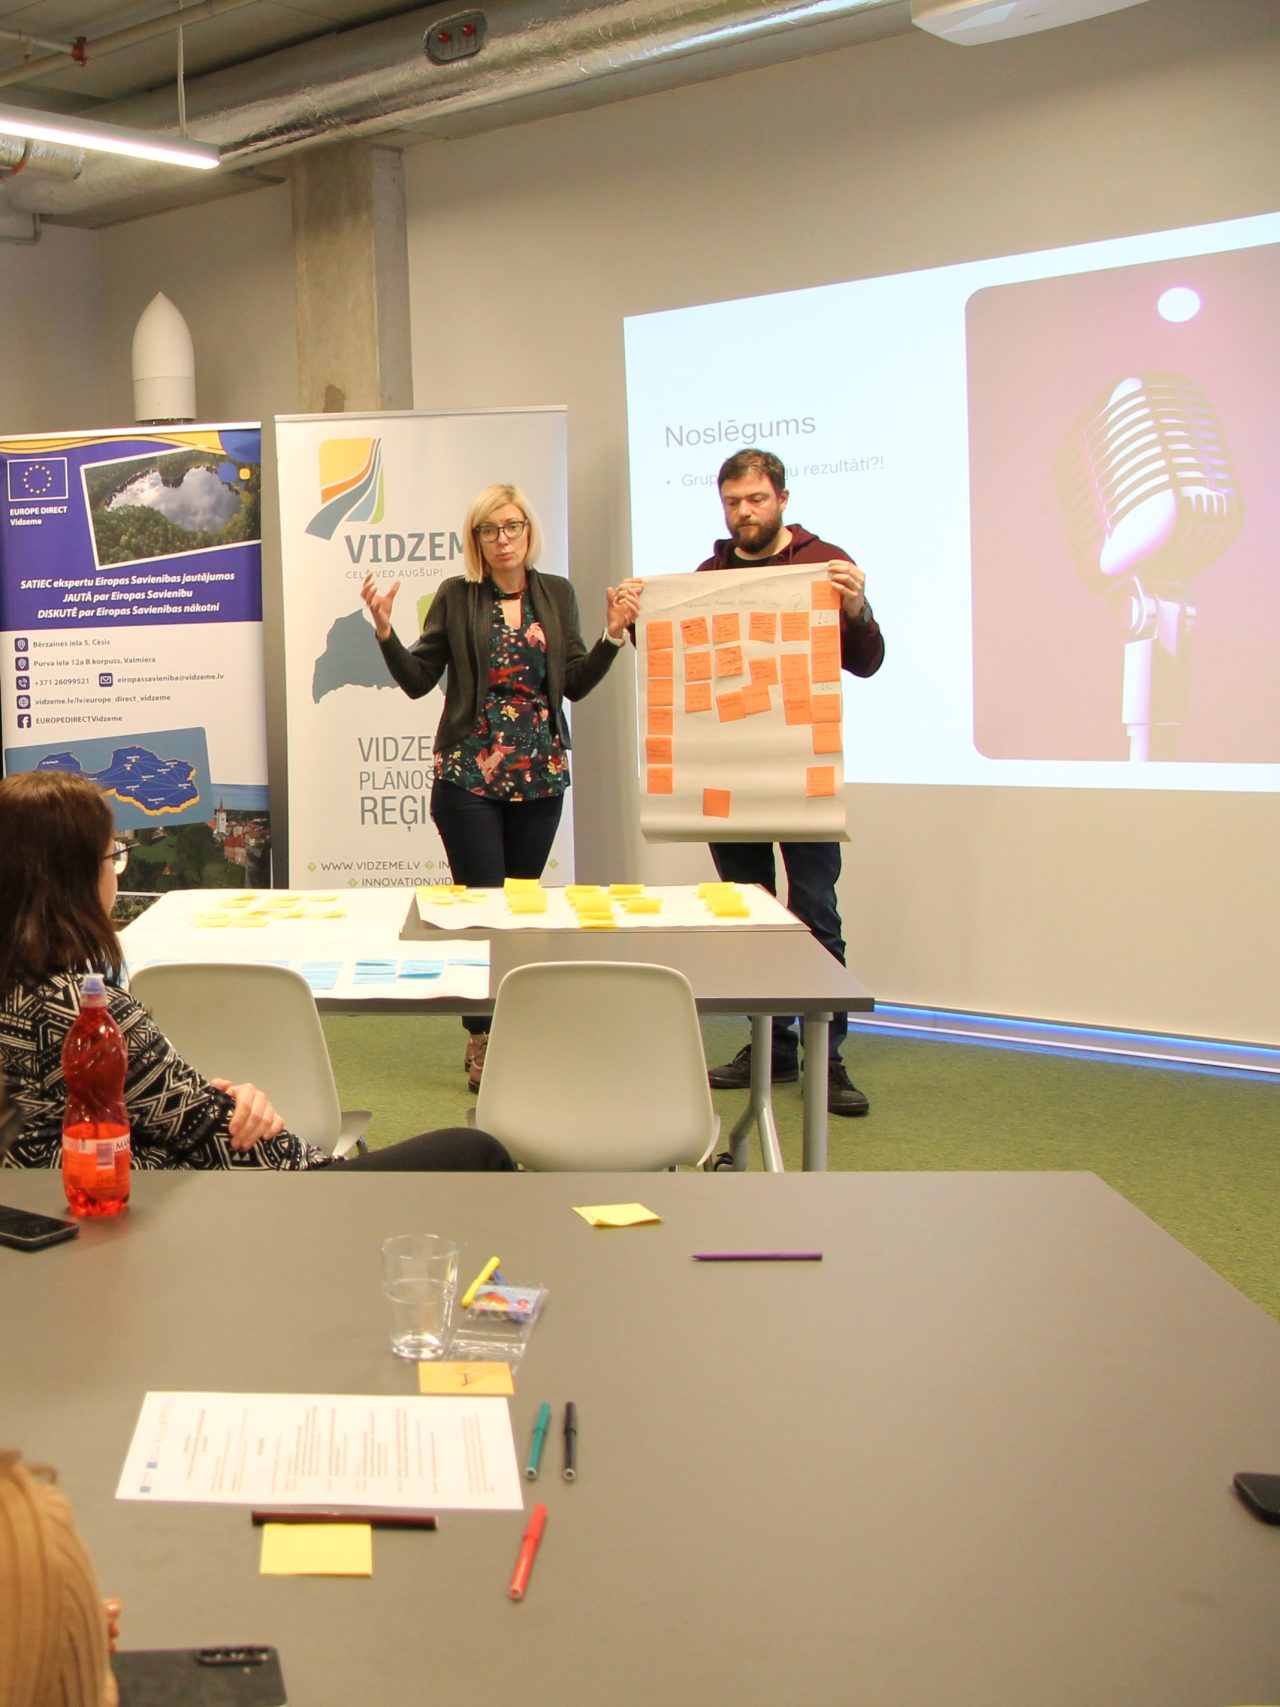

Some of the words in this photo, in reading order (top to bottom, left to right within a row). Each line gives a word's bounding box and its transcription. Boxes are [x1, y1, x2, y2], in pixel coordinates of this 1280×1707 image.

[665, 415, 817, 448] Noslēgums
[681, 472, 720, 488] Grup
[803, 456, 885, 476] rezultāti?!
[9, 507, 40, 516] EUROPE
[40, 505, 68, 515] DIRECT
[9, 518, 43, 526] Vidzeme
[344, 531, 465, 564] VIDZEM
[375, 569, 396, 579] VED
[398, 567, 444, 578] AUGŠUP!
[20, 579, 53, 589] SATIEC
[53, 578, 94, 589] ekspertu
[94, 576, 130, 587] Eiropas
[130, 574, 181, 585] Savienības
[181, 572, 236, 585] jautājumos
[62, 591, 92, 603] JAUTĀ
[92, 593, 110, 603] par
[110, 591, 146, 601] Eiropas
[147, 588, 193, 599] Savienību
[37, 606, 78, 619] DISKUTĒ
[78, 609, 96, 619] par
[96, 606, 131, 617] Eiropas
[132, 603, 183, 615] Savienības
[183, 602, 220, 613] nākotni
[69, 639, 83, 647] iela
[56, 659, 70, 667] iela
[71, 658, 84, 666] 12a
[91, 658, 123, 667] korpuss,
[123, 656, 157, 664] Valmiera
[54, 678, 90, 686] 26099521
[35, 715, 123, 725] EUROPEDIRECTVidzeme
[358, 736, 432, 762] VIDZE
[360, 765, 434, 790] PLĀNOŠ
[360, 795, 426, 832] REĢI
[321, 861, 421, 871] WWW.VIDZEME.LV
[362, 877, 454, 887] INNOVATION.VID
